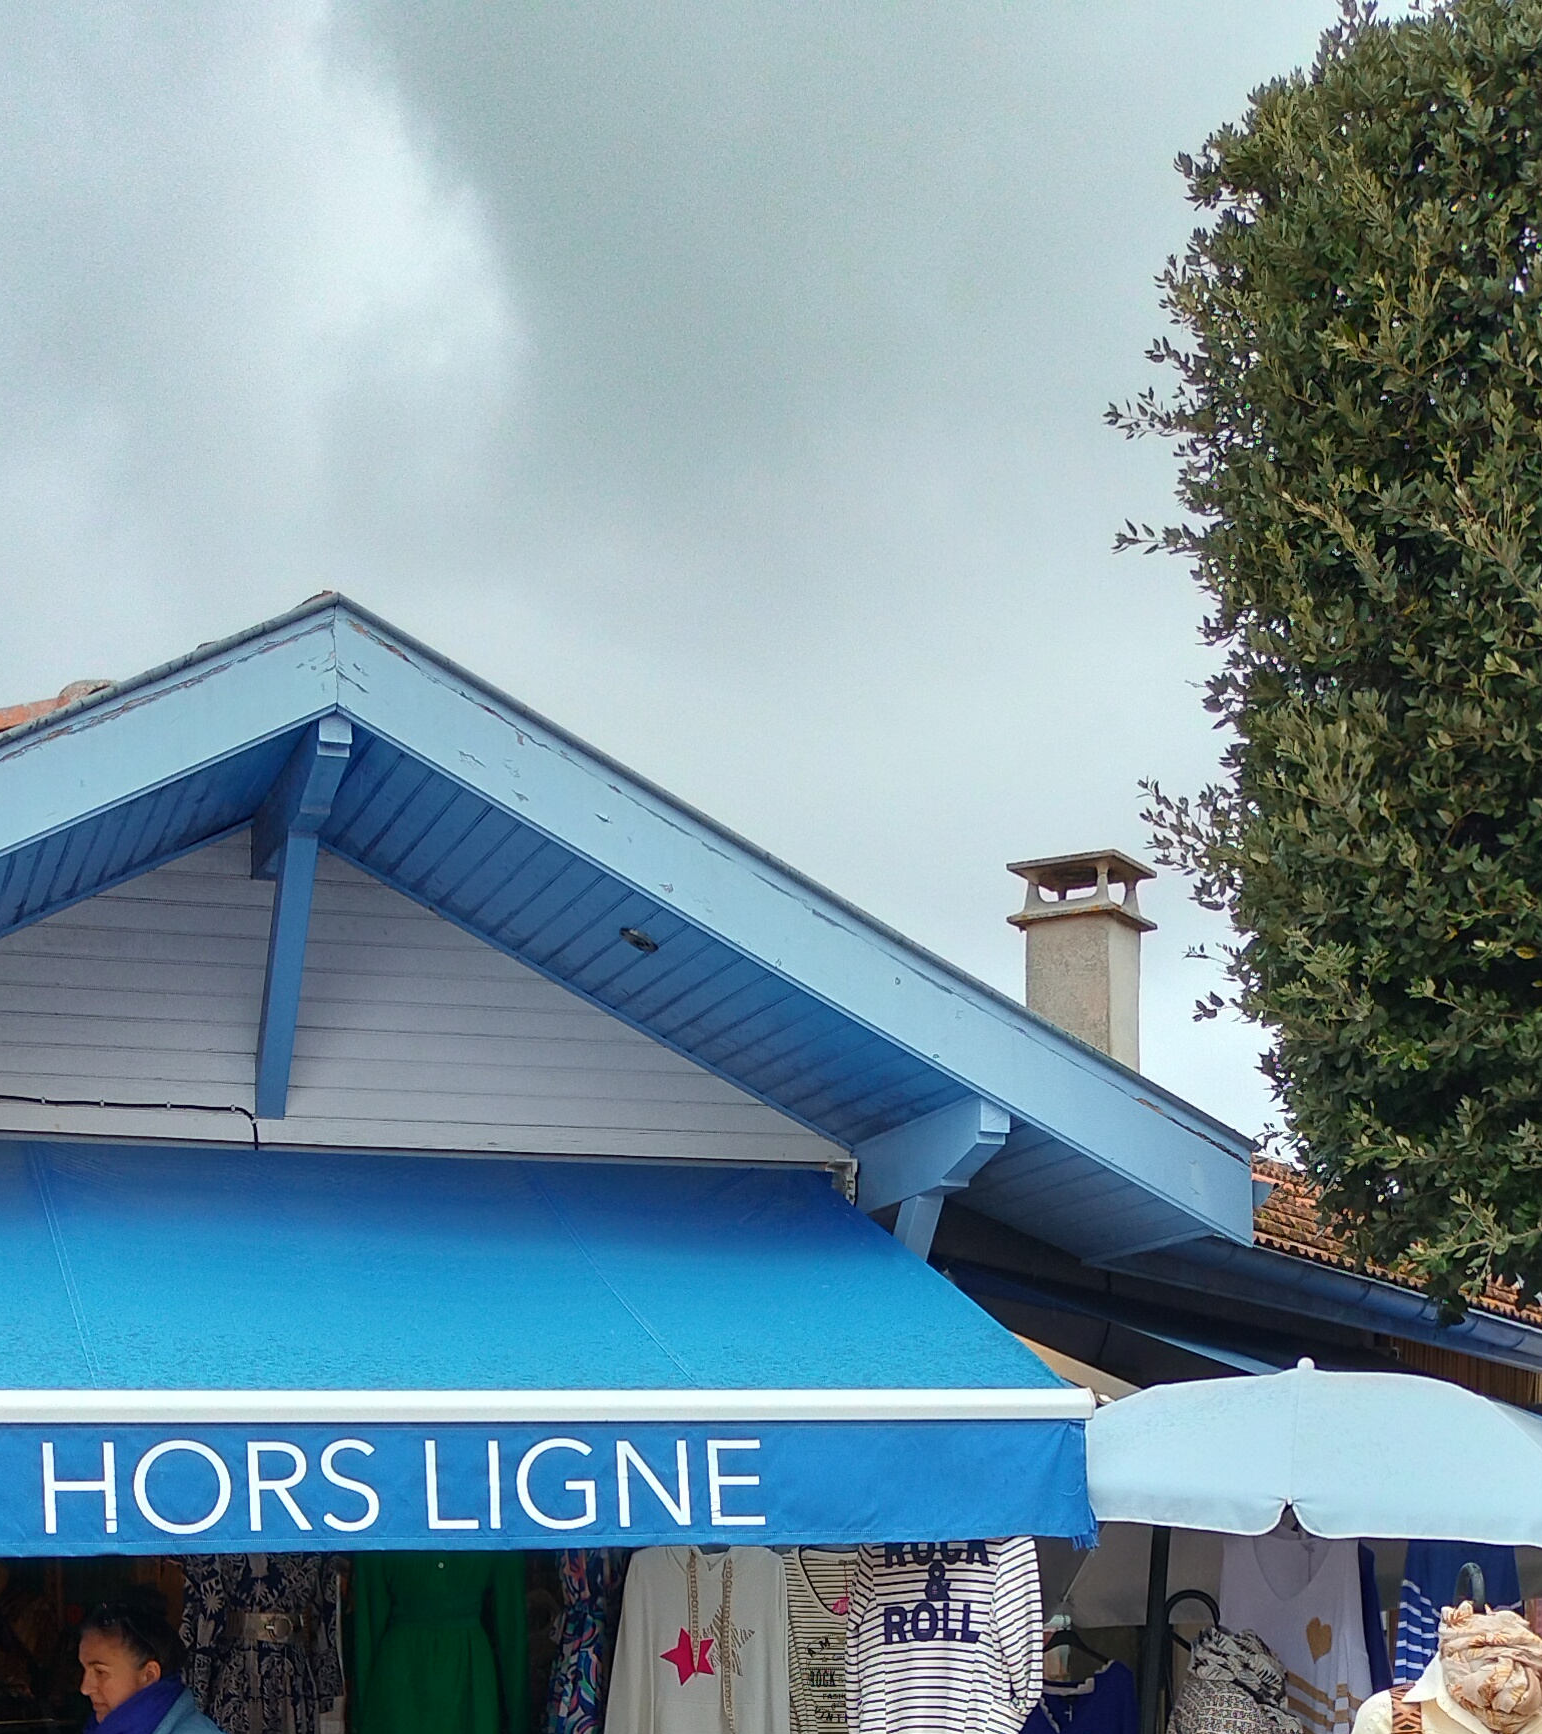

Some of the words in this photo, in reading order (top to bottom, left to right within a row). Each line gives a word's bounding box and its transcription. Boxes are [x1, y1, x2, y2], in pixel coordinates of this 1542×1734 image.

[41, 1438, 381, 1535] HORS
[424, 1437, 767, 1531] LIGNE
[924, 1560, 952, 1601] &
[883, 1601, 981, 1645] ROLL
